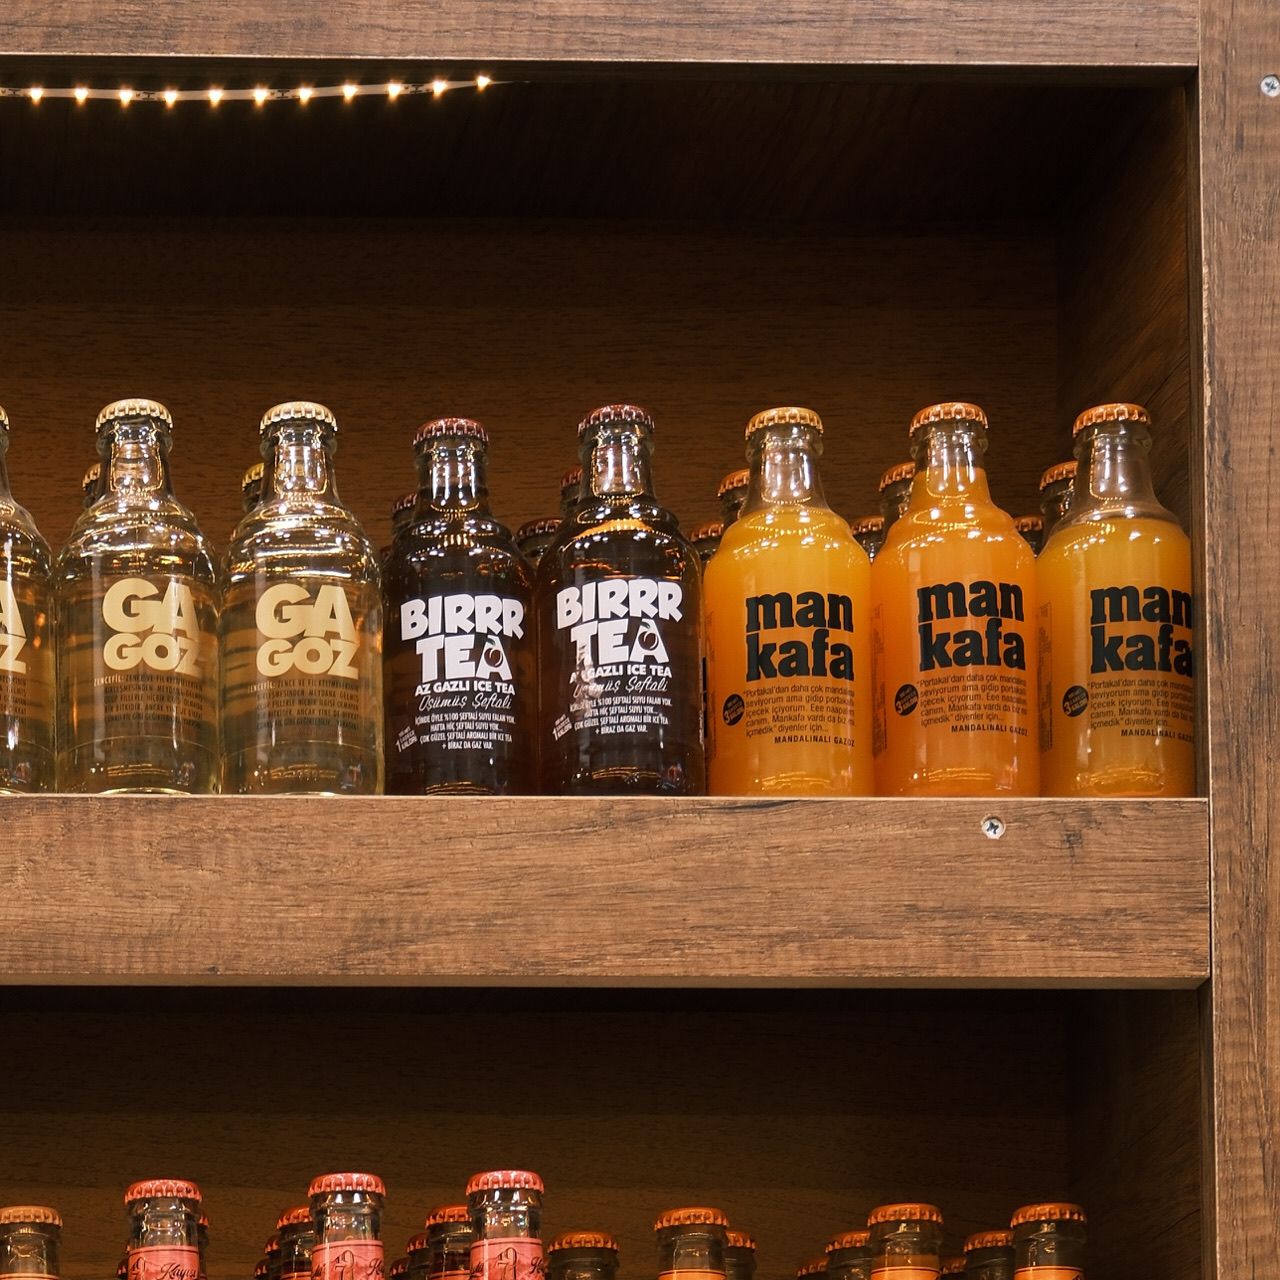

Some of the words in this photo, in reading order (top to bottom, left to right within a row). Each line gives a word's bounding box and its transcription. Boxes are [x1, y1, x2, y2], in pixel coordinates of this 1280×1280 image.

[256, 583, 359, 645] GA
[401, 594, 524, 641] BIRRR
[557, 579, 683, 629] BIRRR
[746, 591, 854, 632] man
[917, 581, 1024, 622] man
[1090, 586, 1192, 629] man
[256, 638, 359, 680] GOZ
[416, 634, 513, 683] TEA
[571, 619, 669, 666] TEA
[746, 629, 854, 682] kafa
[919, 618, 1025, 672] kafa
[1090, 624, 1192, 678] kafa
[415, 684, 431, 696] AZ
[433, 681, 469, 693] GAZLI
[474, 681, 492, 692] ICE
[495, 682, 515, 695] TEA
[587, 665, 623, 679] GAZLI
[627, 665, 646, 675] ICE
[650, 665, 672, 678] TEA
[626, 676, 668, 693] Şeftali
[791, 685, 808, 693] daha
[811, 685, 823, 693] çok
[472, 693, 512, 709] Şeftali
[834, 736, 855, 747] GAZOZ
